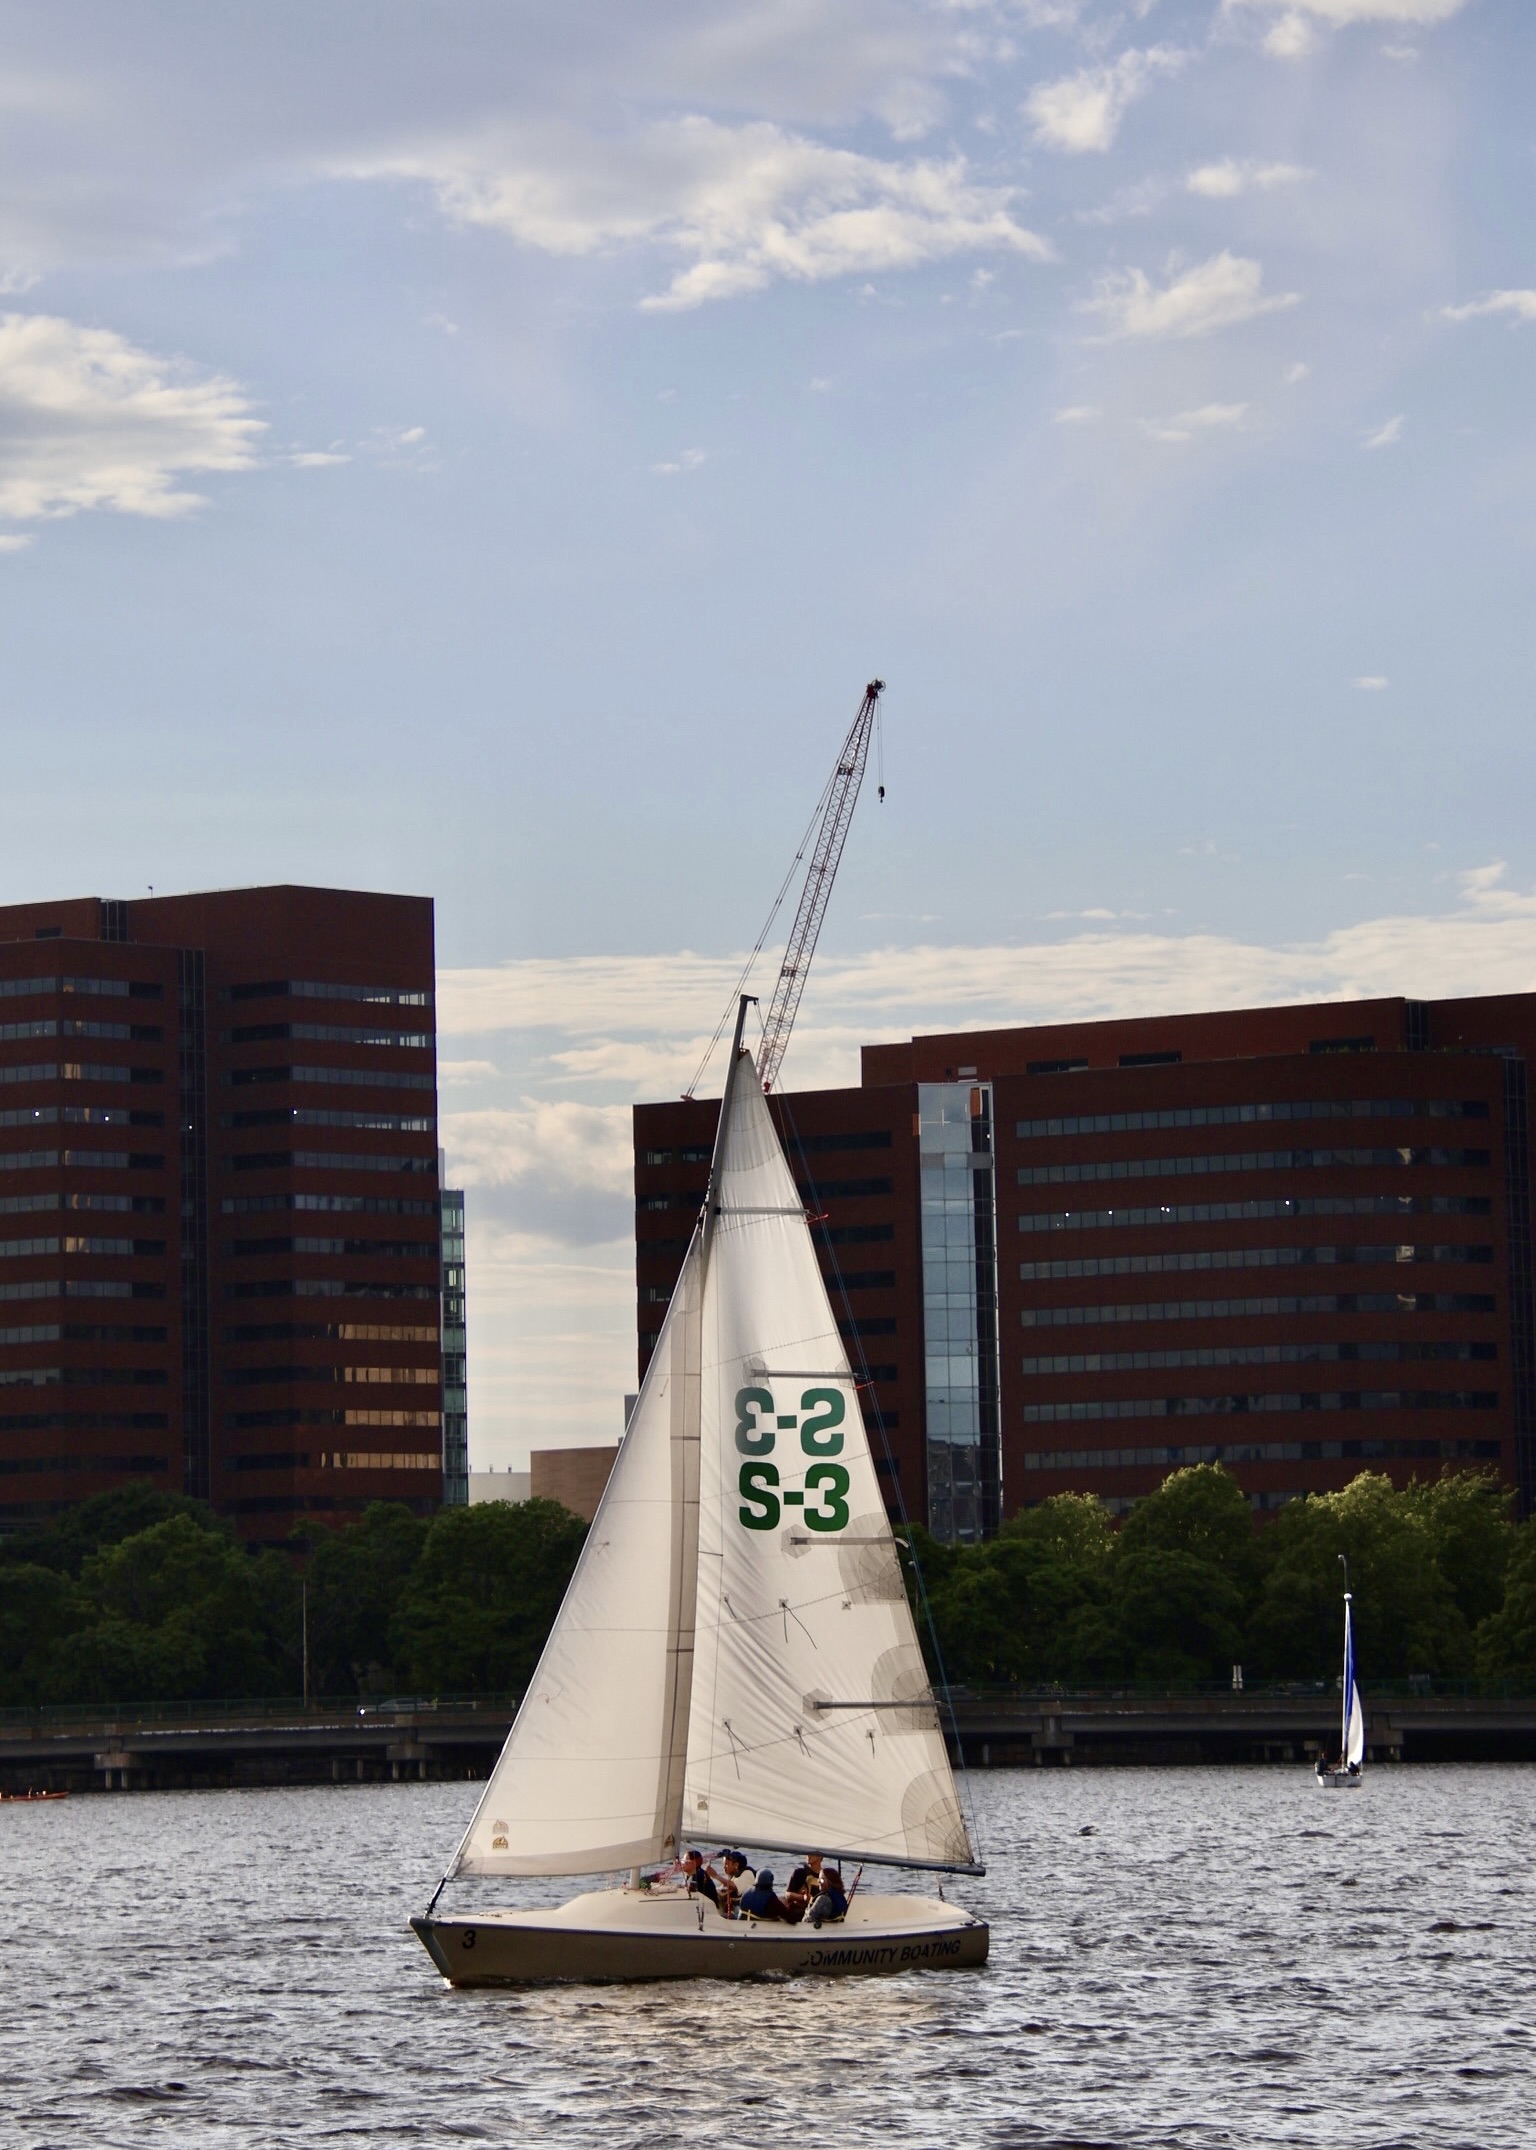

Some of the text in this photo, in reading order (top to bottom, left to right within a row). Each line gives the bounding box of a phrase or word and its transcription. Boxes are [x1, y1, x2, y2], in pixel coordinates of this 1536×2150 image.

[739, 1462, 850, 1531] S-3
[462, 1930, 476, 1949] 3
[901, 1940, 960, 1960] BOATING
